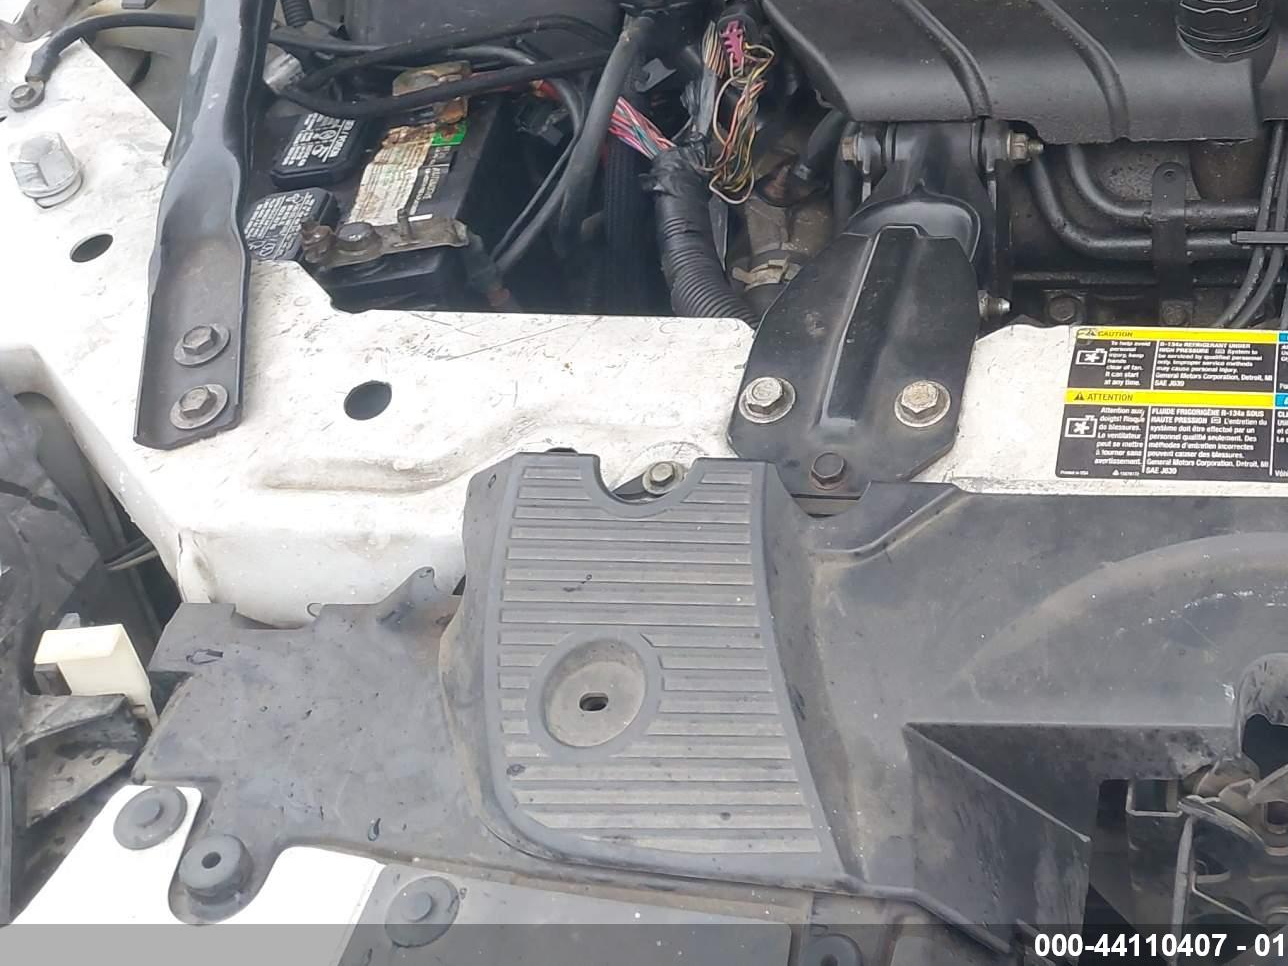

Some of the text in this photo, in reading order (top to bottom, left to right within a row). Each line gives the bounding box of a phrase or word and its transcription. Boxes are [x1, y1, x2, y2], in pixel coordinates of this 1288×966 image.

[1148, 441, 1180, 449] méthodes
[1146, 458, 1172, 466] General
[1196, 459, 1235, 468] Corporation,
